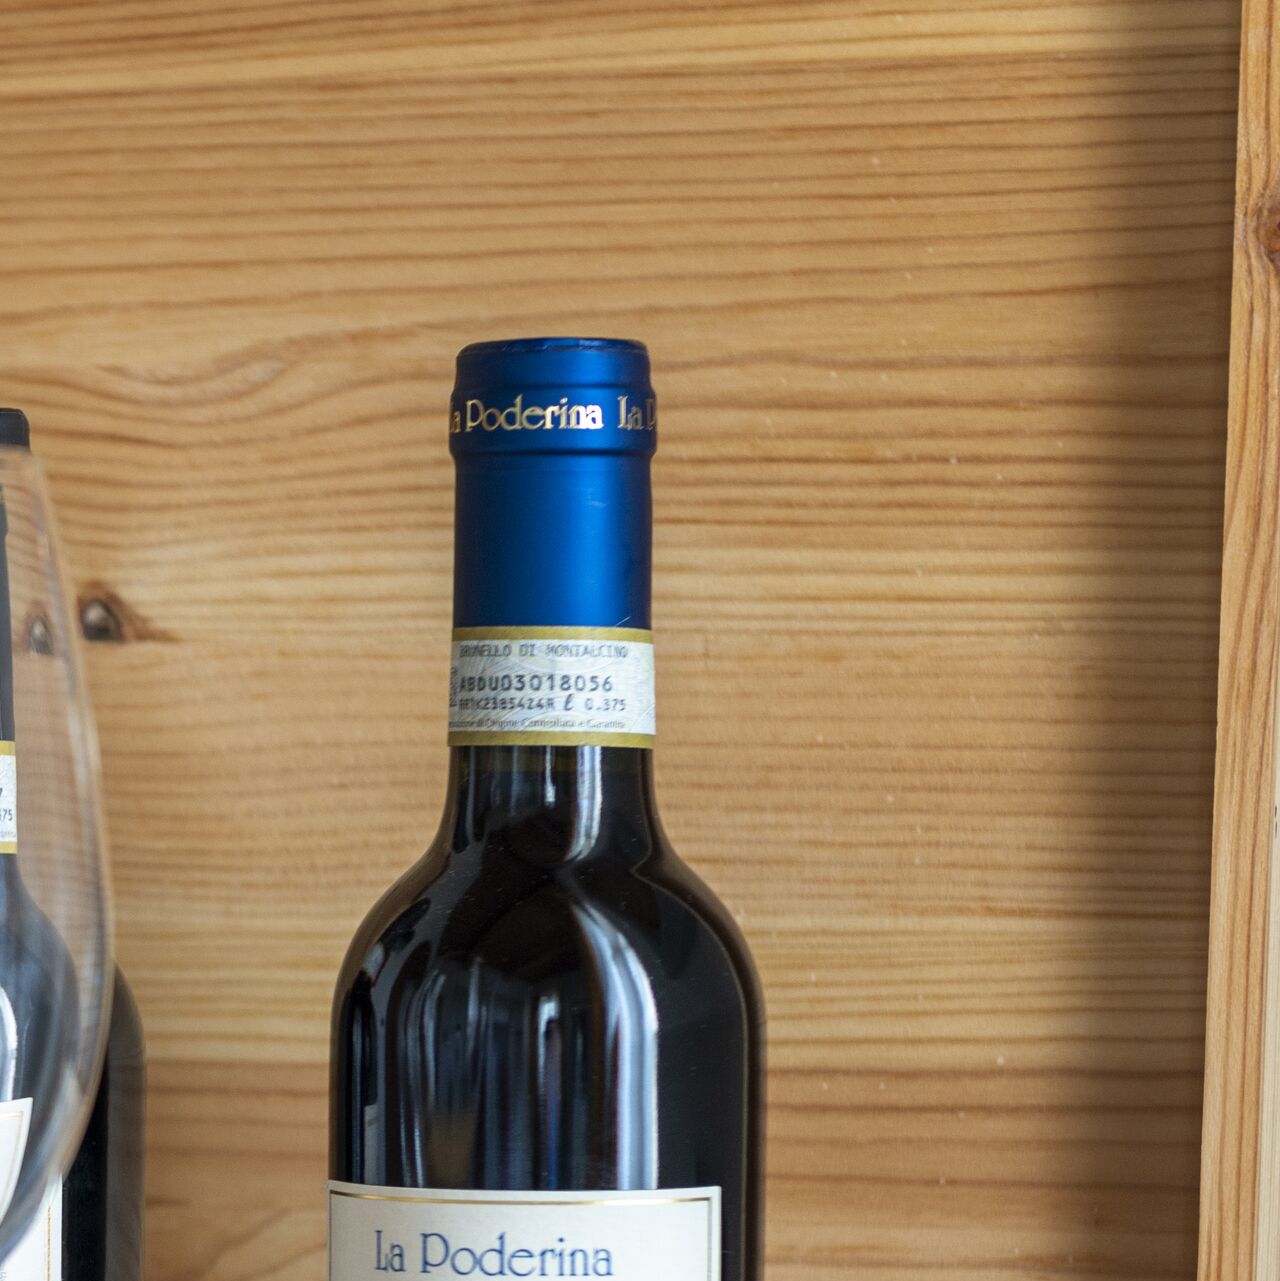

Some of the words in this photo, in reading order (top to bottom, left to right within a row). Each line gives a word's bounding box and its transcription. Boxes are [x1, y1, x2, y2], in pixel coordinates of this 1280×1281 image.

[464, 394, 604, 431] Poderina
[617, 395, 644, 430] La
[519, 644, 535, 656] DI
[545, 644, 628, 659] MONTALCINO
[374, 1229, 407, 1273] La
[419, 1231, 614, 1277] Poderina
